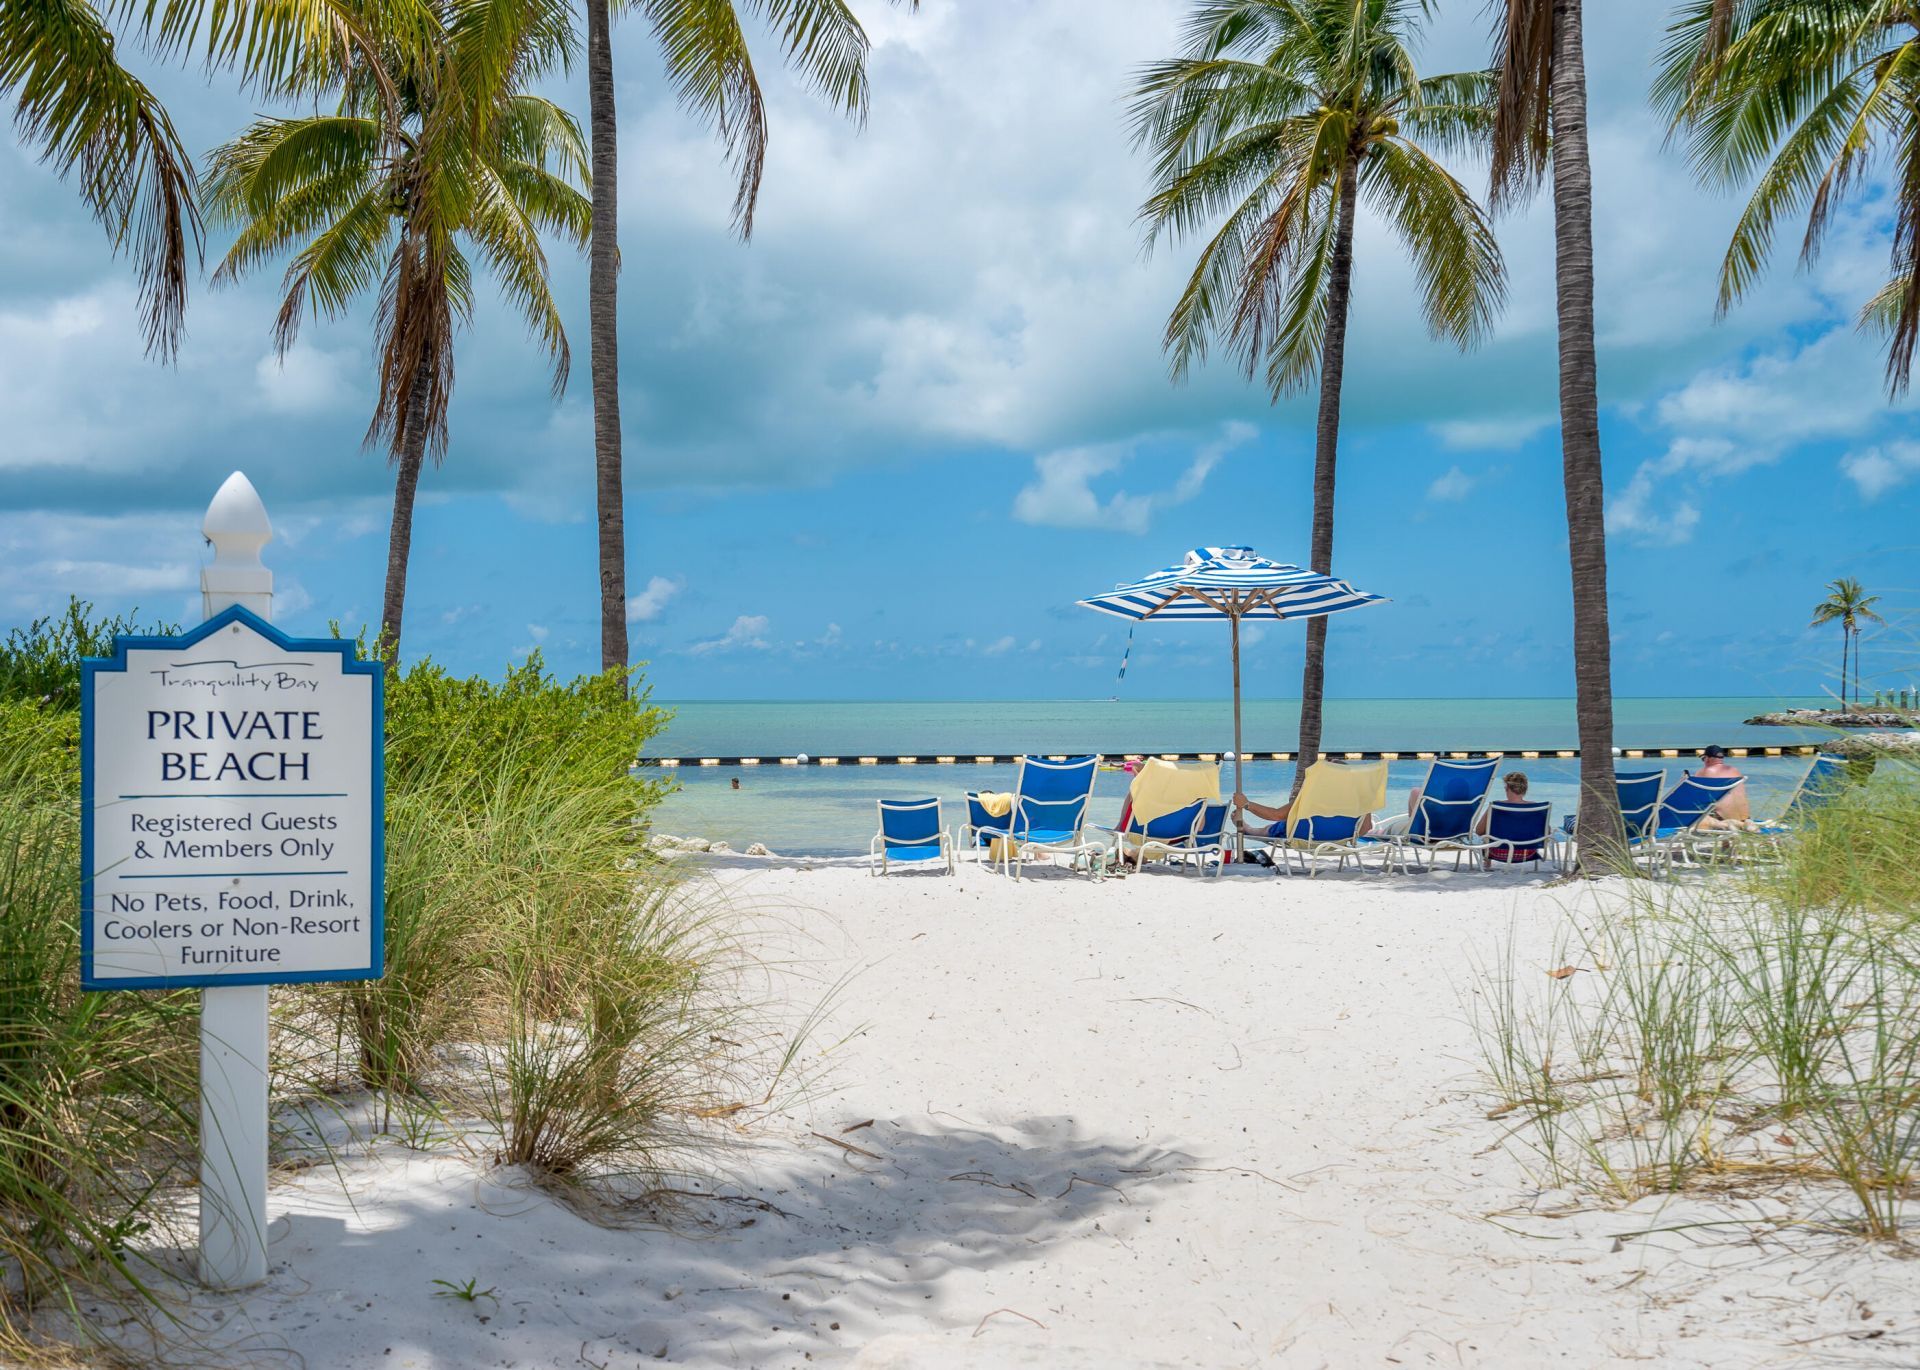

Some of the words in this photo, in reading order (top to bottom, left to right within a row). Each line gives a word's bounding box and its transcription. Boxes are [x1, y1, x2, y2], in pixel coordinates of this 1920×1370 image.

[150, 670, 272, 695] Tranquility
[274, 671, 319, 692] Bay
[147, 711, 323, 740] PRIVATE
[161, 752, 310, 782] BEACH
[130, 813, 252, 836] Registered
[261, 811, 337, 831] Guests
[134, 841, 153, 859] &
[163, 840, 272, 859] Members
[280, 838, 334, 860] Only
[111, 893, 144, 913] No
[155, 892, 208, 912] Pets,
[219, 891, 280, 911] Food,
[289, 889, 354, 908] Drink,
[103, 919, 193, 940] Coolers
[200, 923, 224, 937] or
[232, 915, 361, 936] Non-Resort
[181, 944, 281, 964] Furniture
